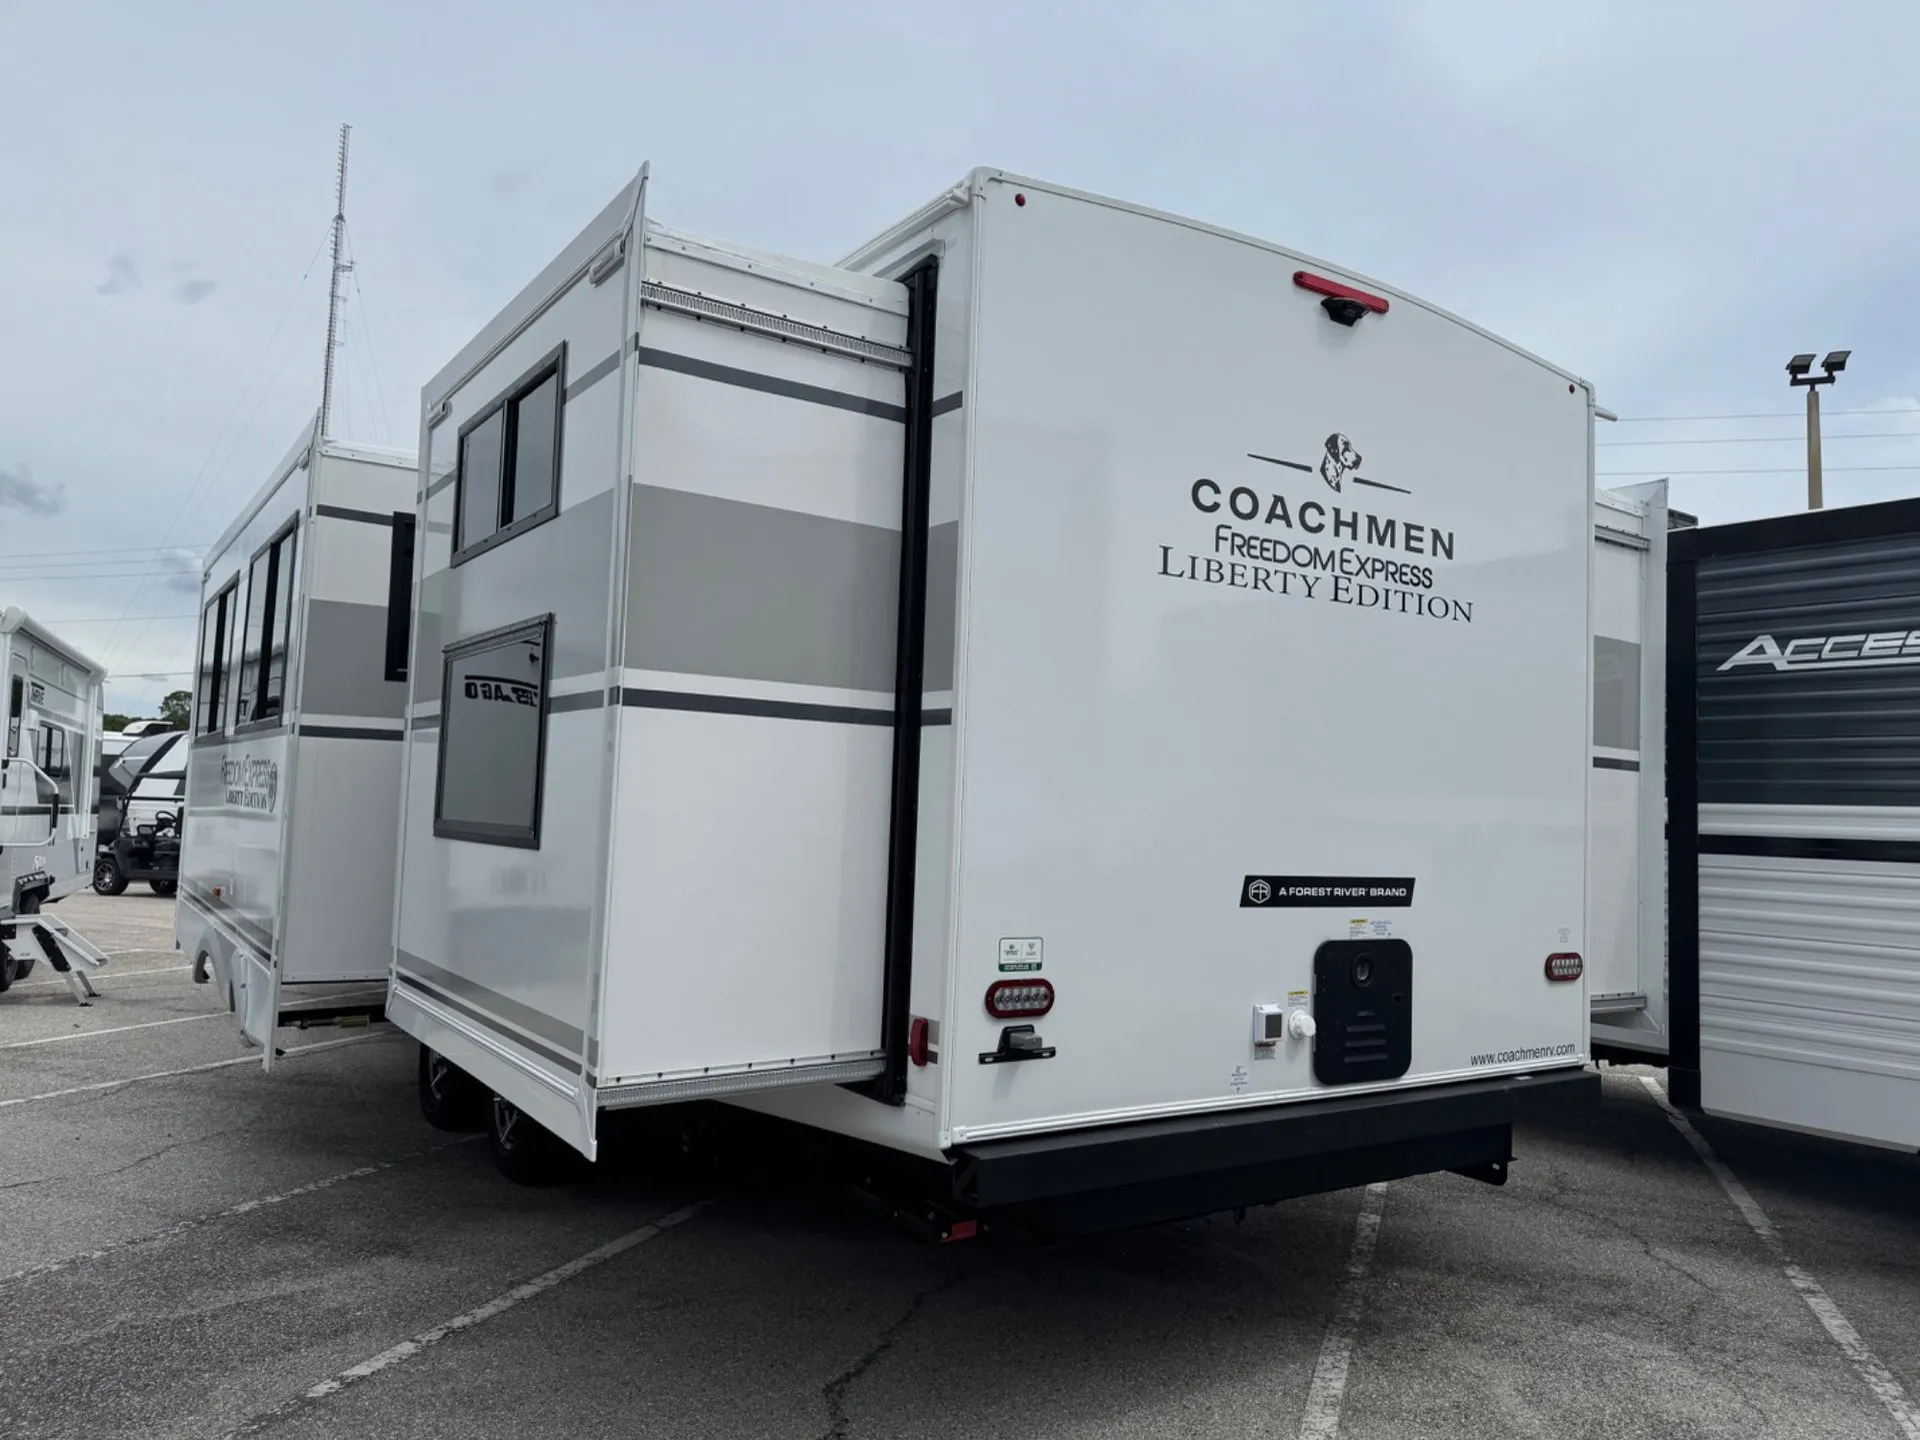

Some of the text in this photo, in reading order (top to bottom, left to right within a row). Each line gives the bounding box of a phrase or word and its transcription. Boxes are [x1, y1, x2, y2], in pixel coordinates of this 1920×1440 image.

[1191, 478, 1454, 560] COACHMEN
[1158, 544, 1474, 623] LIBERTY EDITION
[1278, 887, 1407, 897] A FOREST RIVER BRAND
[1470, 1043, 1576, 1066] www.coachmenrv.com
